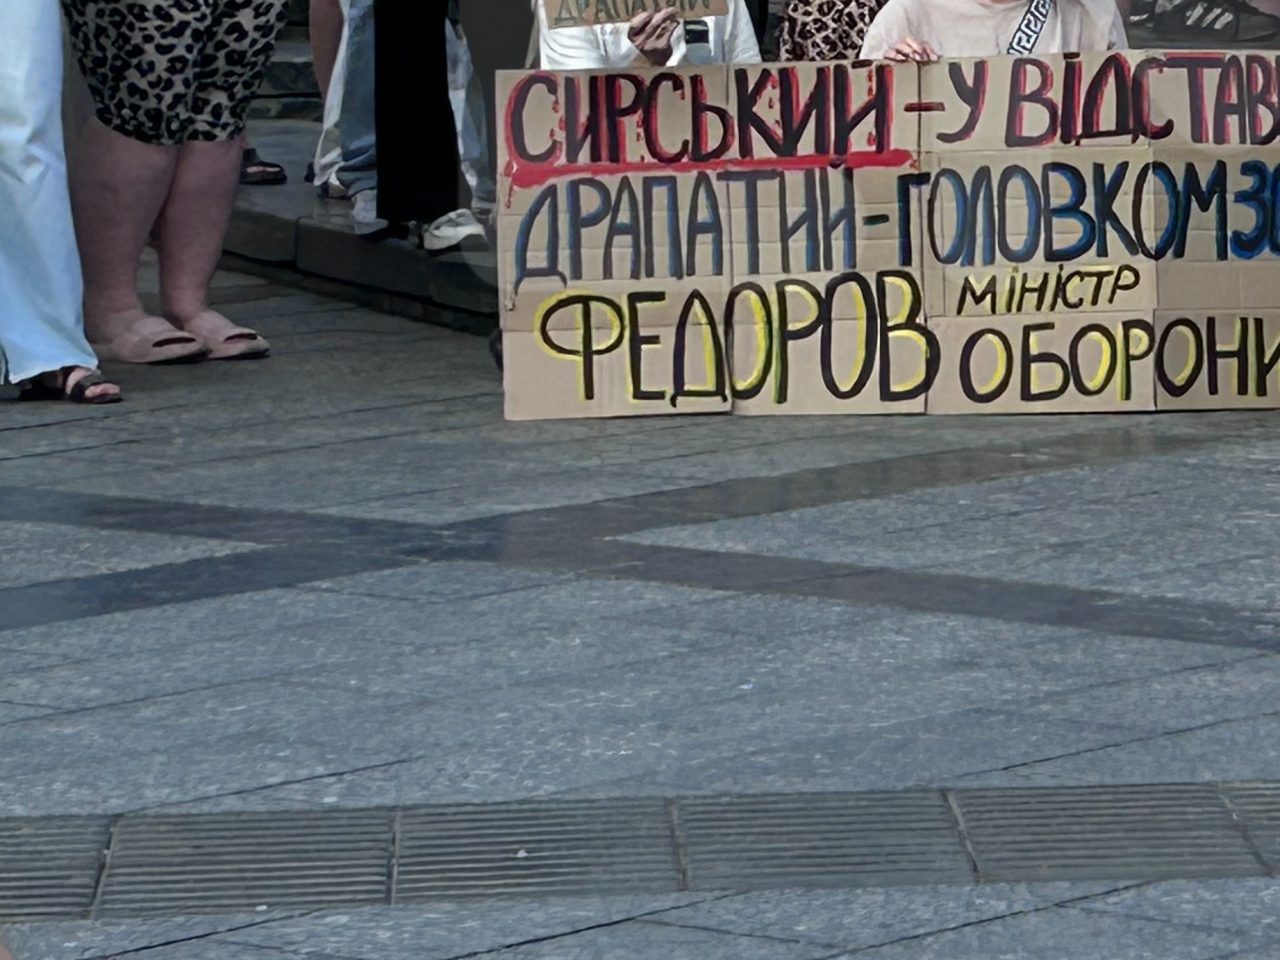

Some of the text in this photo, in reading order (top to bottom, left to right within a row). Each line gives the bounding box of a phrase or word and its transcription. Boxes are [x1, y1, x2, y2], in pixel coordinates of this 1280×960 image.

[506, 60, 894, 165] СИРСЬКИЙ
[536, 271, 940, 406] ФЕДОРОВ
[957, 264, 1140, 315] МІНІСТР
